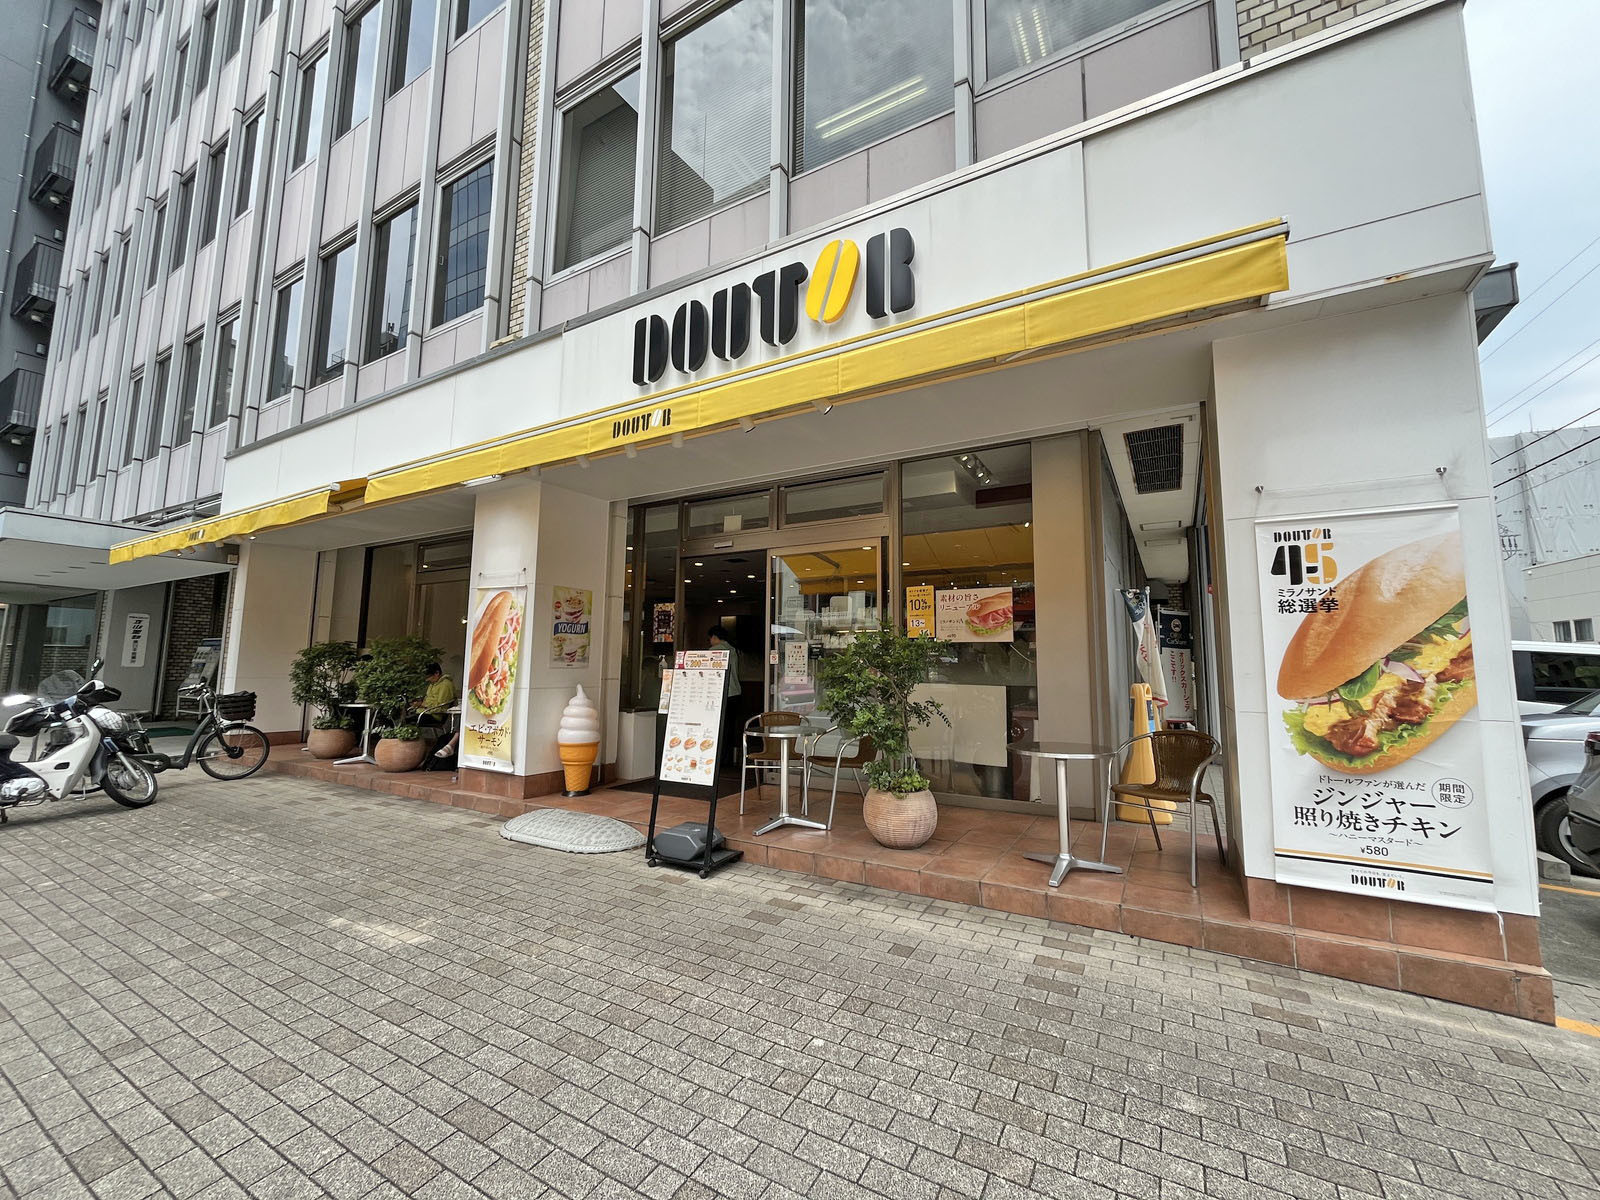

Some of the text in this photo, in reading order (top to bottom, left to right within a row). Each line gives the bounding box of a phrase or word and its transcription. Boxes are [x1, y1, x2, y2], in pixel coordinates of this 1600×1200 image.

[633, 227, 916, 387] DOUTOR
[612, 408, 672, 439] DOUTOR
[1273, 527, 1332, 543] DOUTOR
[1270, 542, 1338, 586] 45
[940, 593, 979, 603] 素材の旨さ
[1277, 586, 1337, 598] ミラノサンド
[940, 603, 981, 611] リニューアル
[1277, 598, 1340, 615] 総選挙
[557, 622, 586, 634] YOGURN
[477, 734, 503, 747] サーモン
[1318, 775, 1427, 792] ドトールファンが選んだ
[1438, 782, 1466, 795] 期間
[1312, 786, 1437, 815] ジンジャー
[1439, 792, 1467, 805] 限定
[1293, 805, 1463, 840] 照り焼きチキン
[1359, 845, 1390, 857] ¥580
[1351, 874, 1405, 891] DOUTOR
